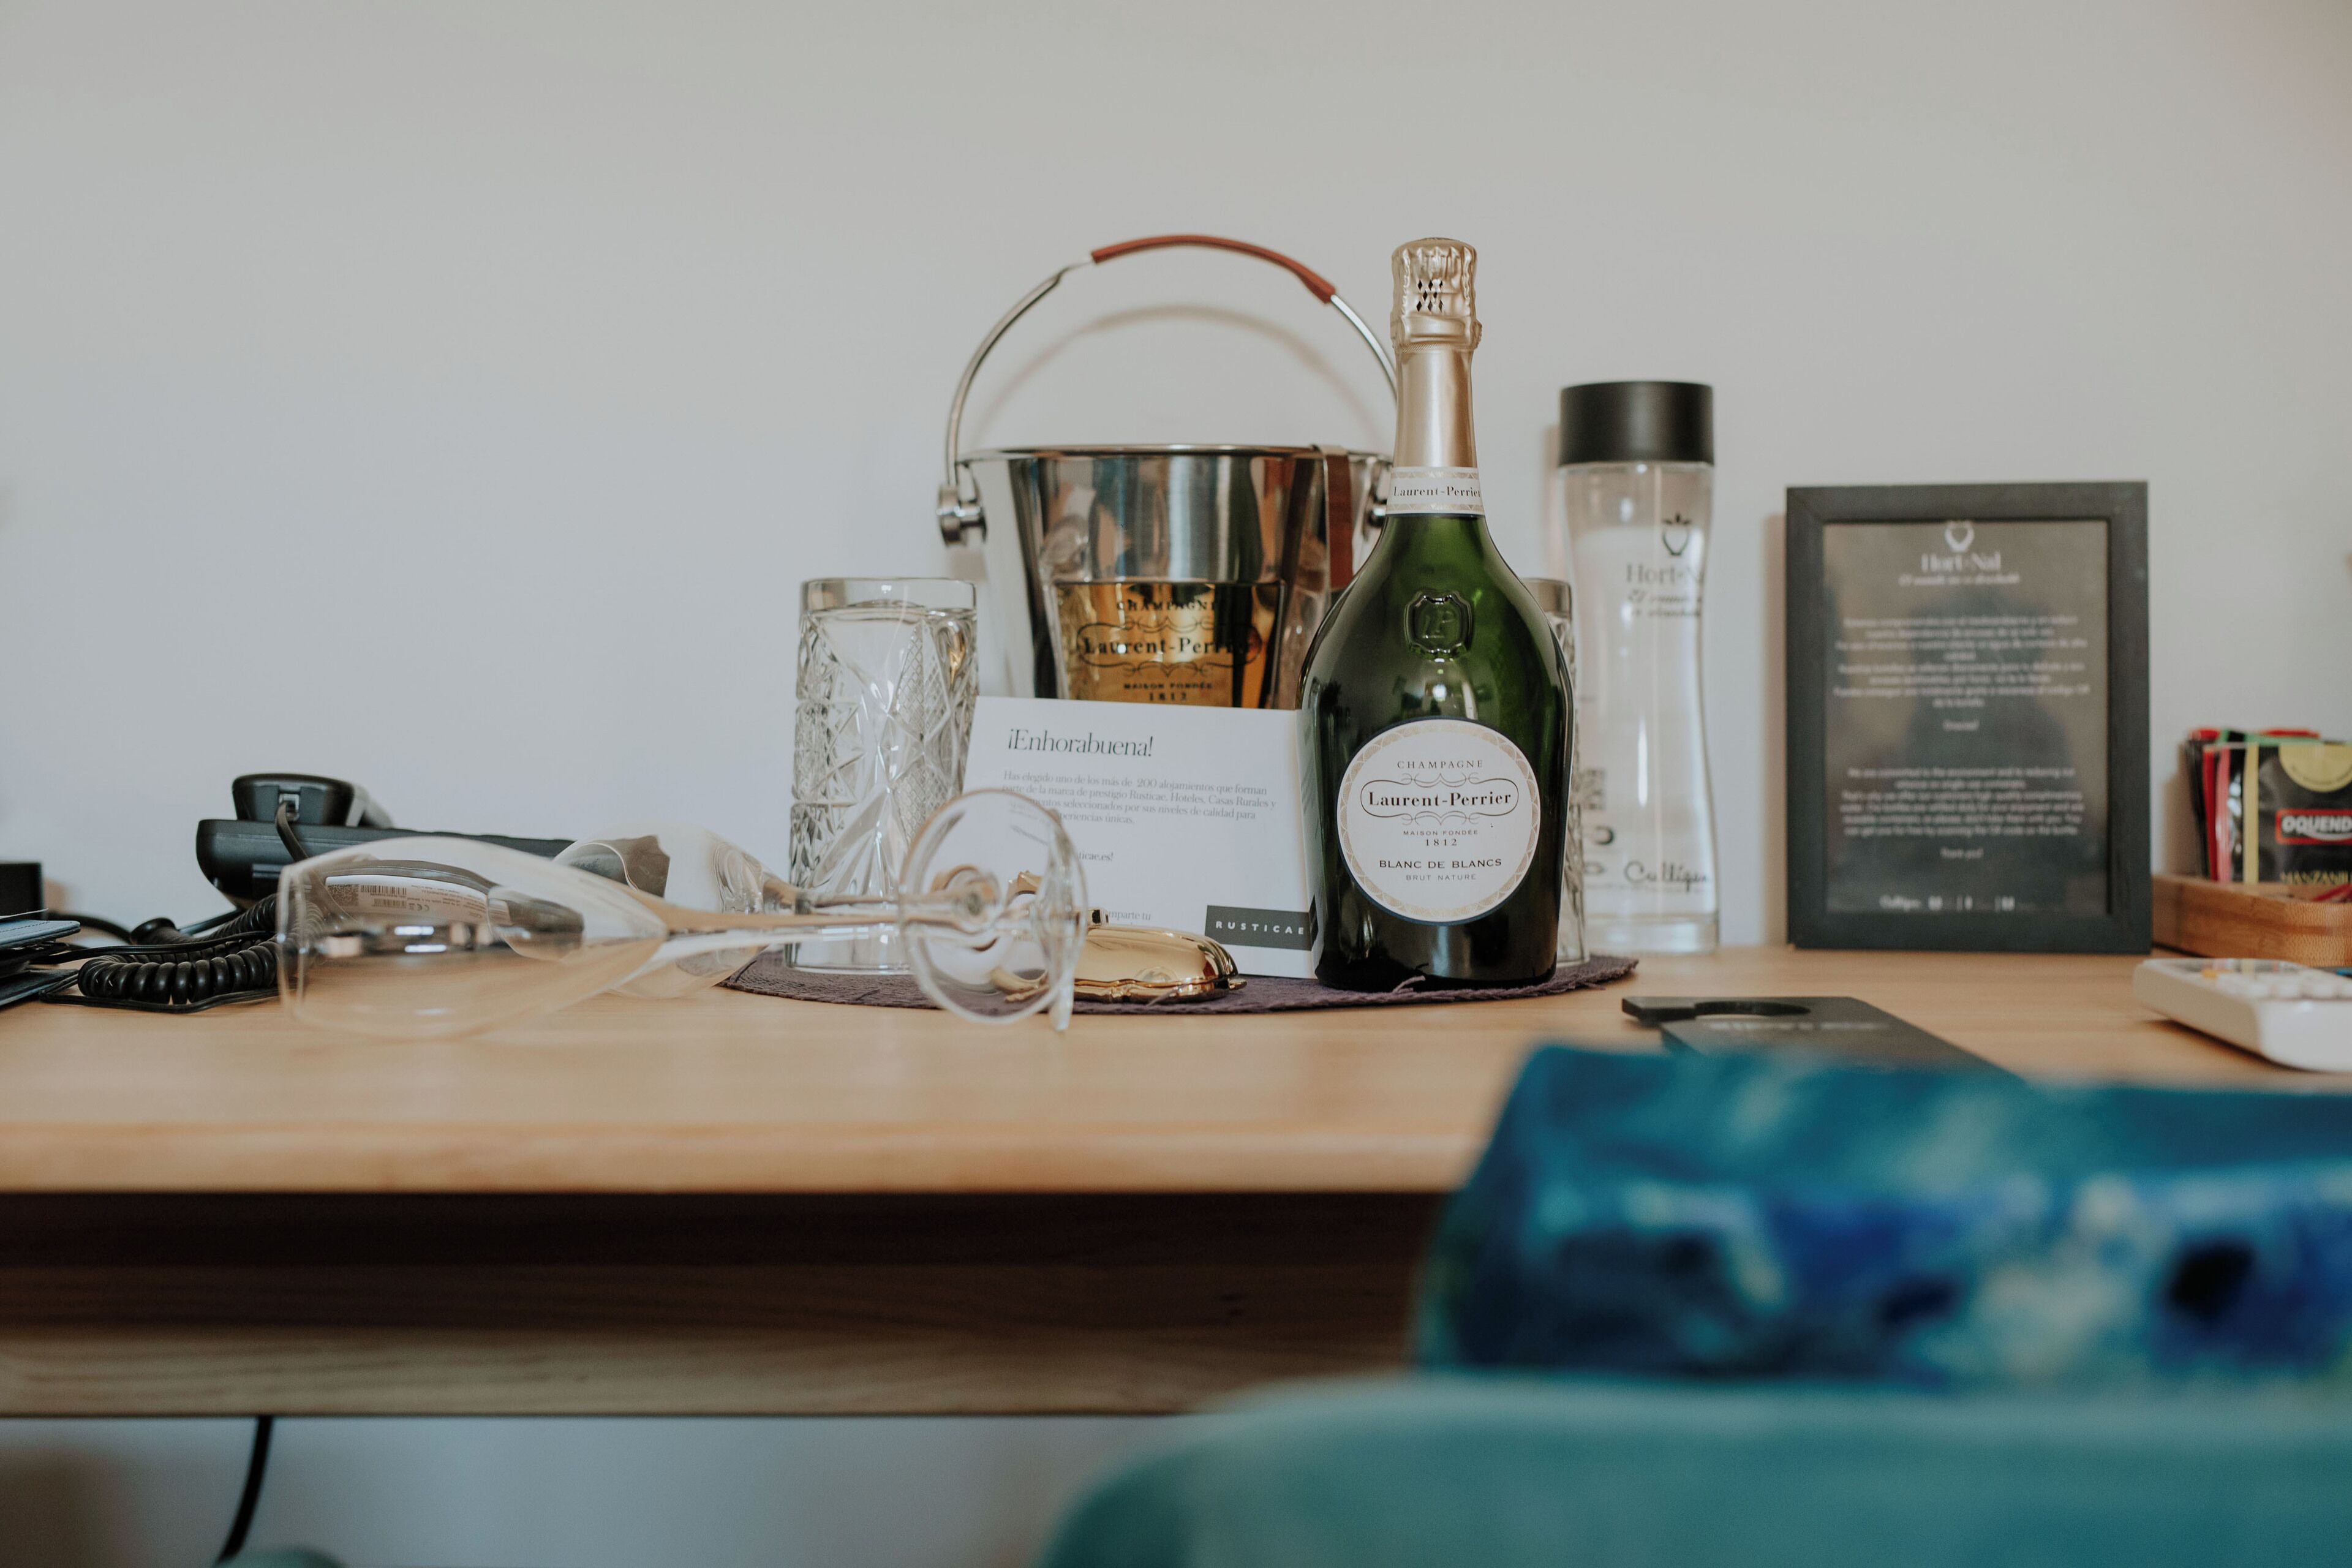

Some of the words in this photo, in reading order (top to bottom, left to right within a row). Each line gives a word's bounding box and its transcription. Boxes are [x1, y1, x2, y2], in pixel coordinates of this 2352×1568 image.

[1149, 692, 1187, 701] 1812
[1008, 729, 1154, 758] ¡Enhorabuena!
[1397, 760, 1483, 769] CHAMPAGNE
[1003, 770, 1020, 780] Has
[1022, 771, 1054, 783] elegido
[1074, 774, 1086, 783] de
[1087, 774, 1099, 785] los
[1101, 776, 1120, 786] más
[1121, 777, 1133, 786] de
[1137, 778, 1157, 788] 200
[1159, 779, 1214, 791] alojamientos
[1216, 785, 1234, 795] que
[1235, 783, 1267, 794] forman
[1025, 784, 1038, 793] de
[1039, 785, 1047, 794] la
[1076, 786, 1088, 796] de
[1089, 788, 1127, 799] prestigio
[1208, 796, 1234, 806] Casas
[1236, 796, 1268, 808] Rurales
[1270, 801, 1276, 810] y
[1368, 790, 1512, 807] Laurent-Perrier
[1063, 799, 1123, 811] seleccionados
[1158, 804, 1188, 815] niveles
[1189, 806, 1202, 816] de
[1203, 807, 1234, 818] calidad
[1235, 812, 1256, 821] para
[1060, 812, 1103, 822] periencias
[1105, 814, 1135, 824] únicas.
[1425, 838, 1458, 846] 1812
[1379, 859, 1422, 869] BLANC
[1428, 860, 1446, 869] DE
[1452, 858, 1502, 869] BLANCS
[1437, 873, 1477, 881] NATURE
[1108, 911, 1141, 922] mparte
[1142, 912, 1152, 921] tu
[1215, 919, 1305, 936] RUSTICAE
